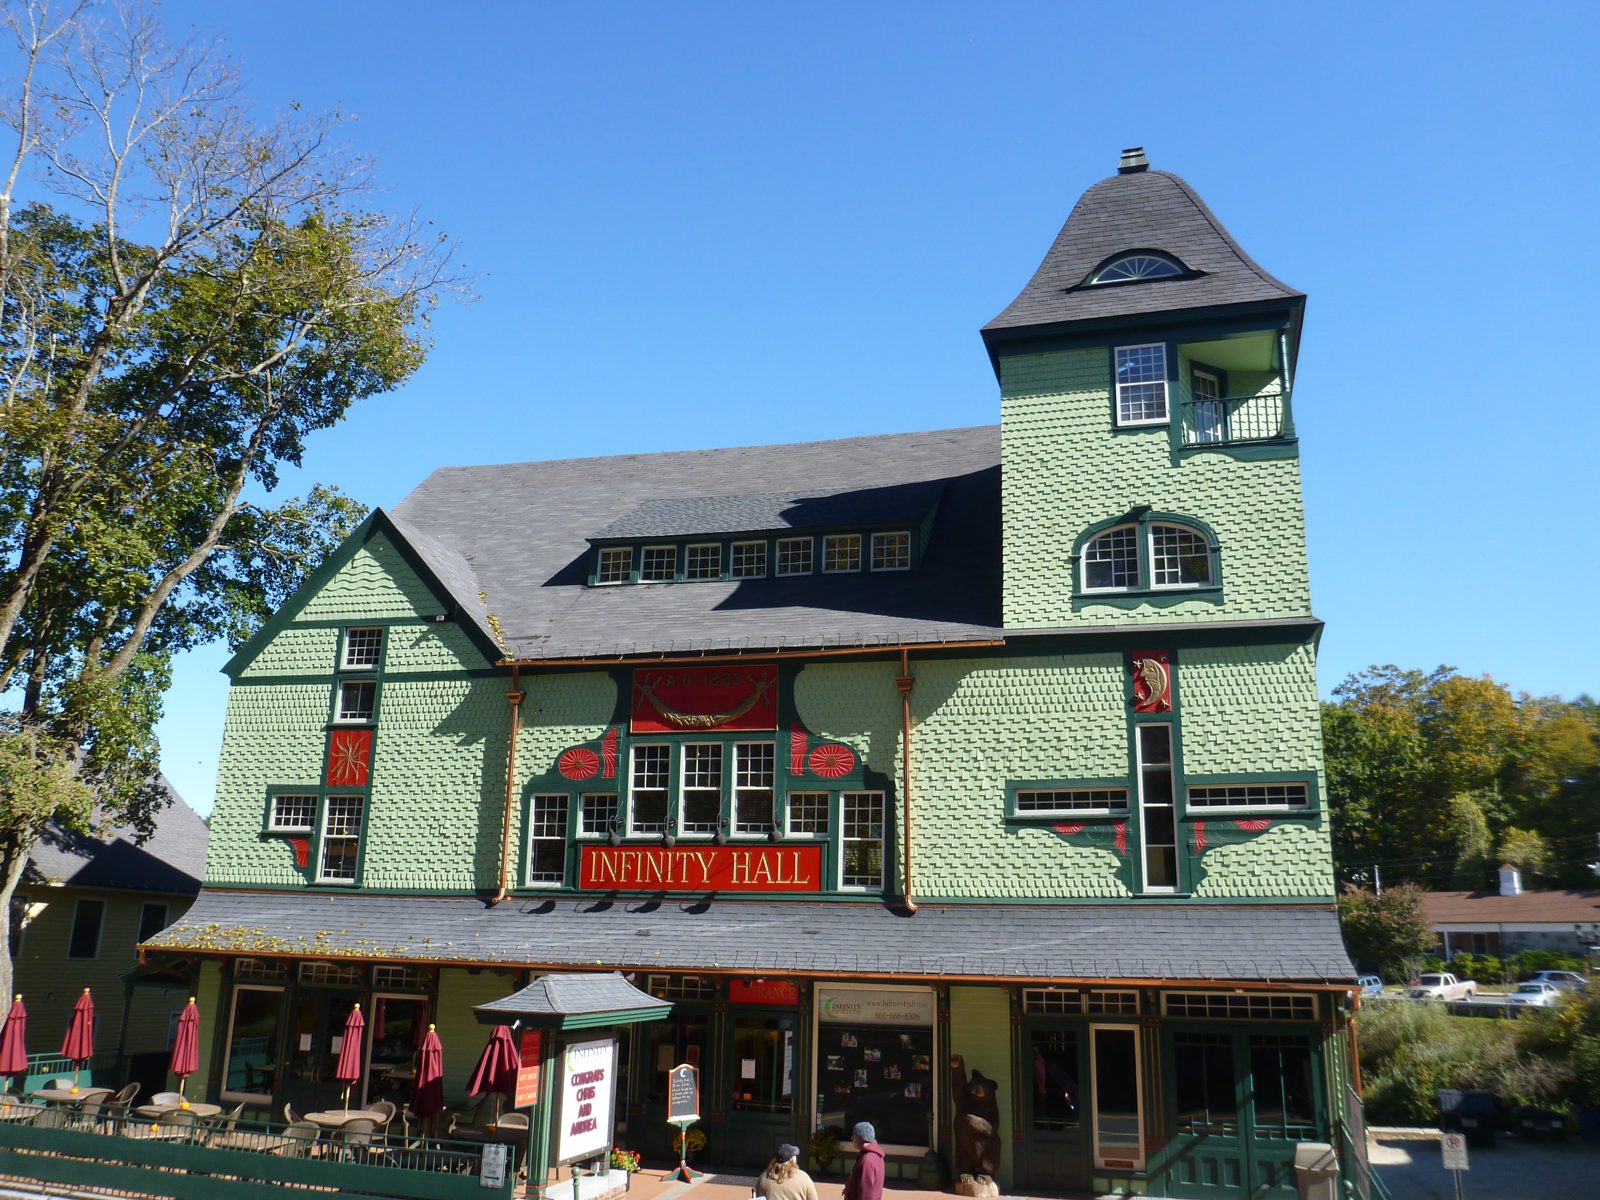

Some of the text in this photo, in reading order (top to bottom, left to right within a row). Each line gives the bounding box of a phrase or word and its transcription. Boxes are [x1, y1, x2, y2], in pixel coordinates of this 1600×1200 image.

[590, 850, 810, 885] INFINITY HALL
[574, 1044, 608, 1060] INFINITY
[571, 1069, 604, 1087] CONGRATS
[576, 1086, 596, 1102] CHRIS
[578, 1103, 592, 1118] AND
[570, 1117, 597, 1137] ANDREA
